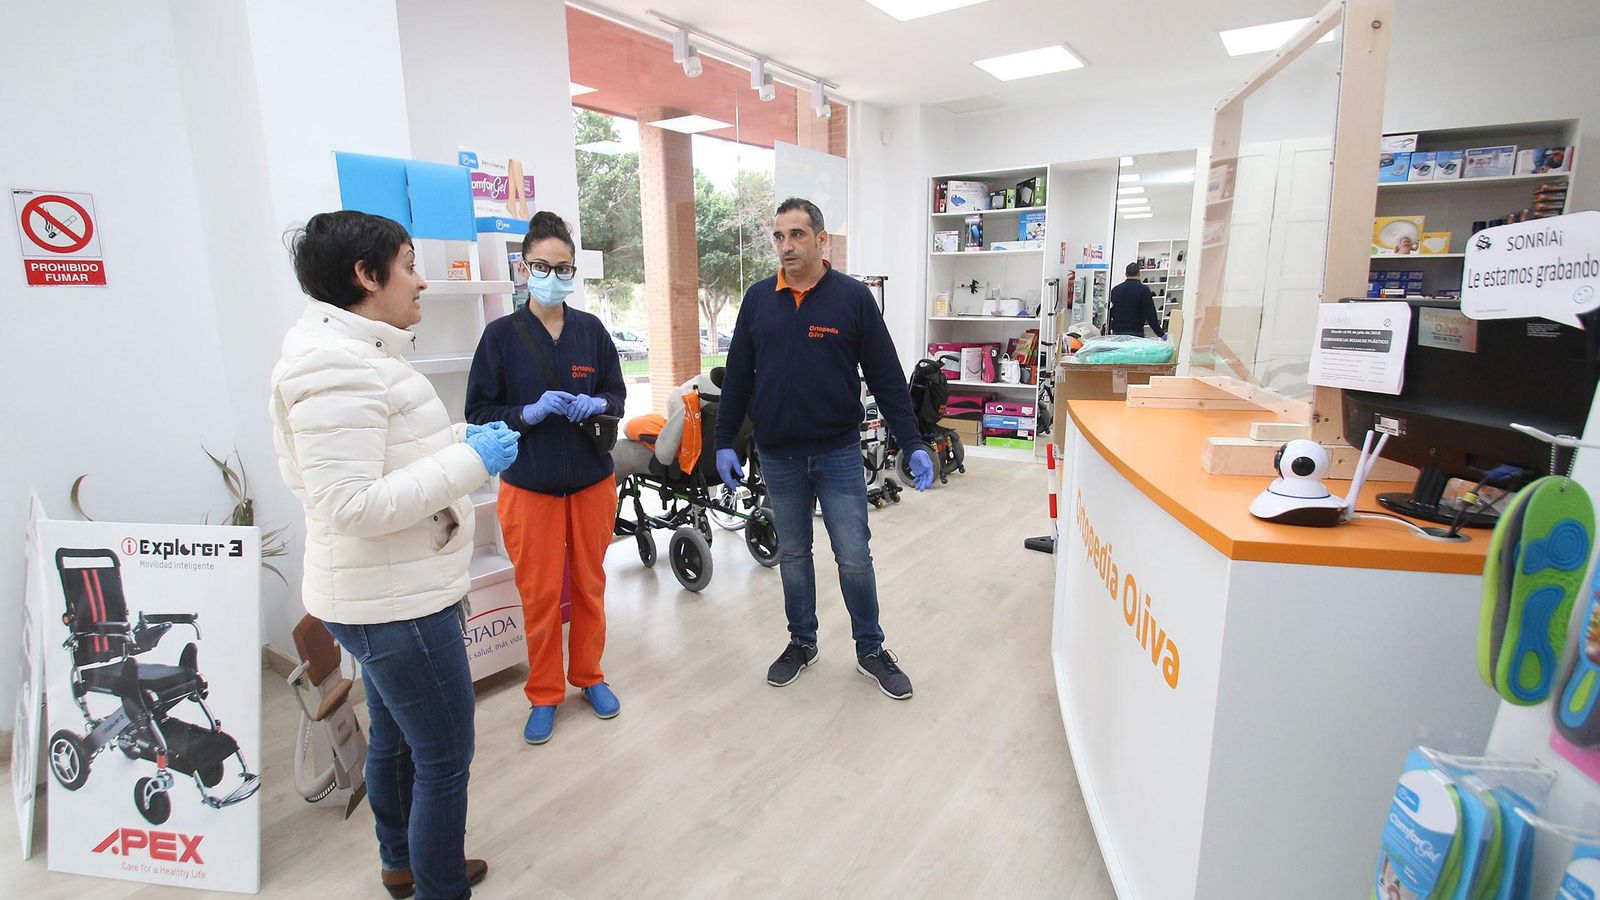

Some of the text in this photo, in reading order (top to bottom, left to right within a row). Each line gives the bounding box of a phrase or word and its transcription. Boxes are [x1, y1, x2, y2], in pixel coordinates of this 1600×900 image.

[472, 176, 508, 198] omforGel
[31, 263, 99, 273] PROHIBIDO
[45, 273, 89, 282] FUMAR
[1467, 253, 1600, 289] Le estamos grabando
[140, 560, 215, 571] Movilidad inteligente
[1076, 488, 1180, 690] Ortopedia Oliva
[463, 615, 516, 647] STADA
[509, 634, 523, 645] vida
[91, 827, 205, 865] APEX
[122, 861, 139, 872] Care
[140, 862, 152, 873] for
[160, 865, 190, 879] Healthy
[191, 869, 206, 880] Life
